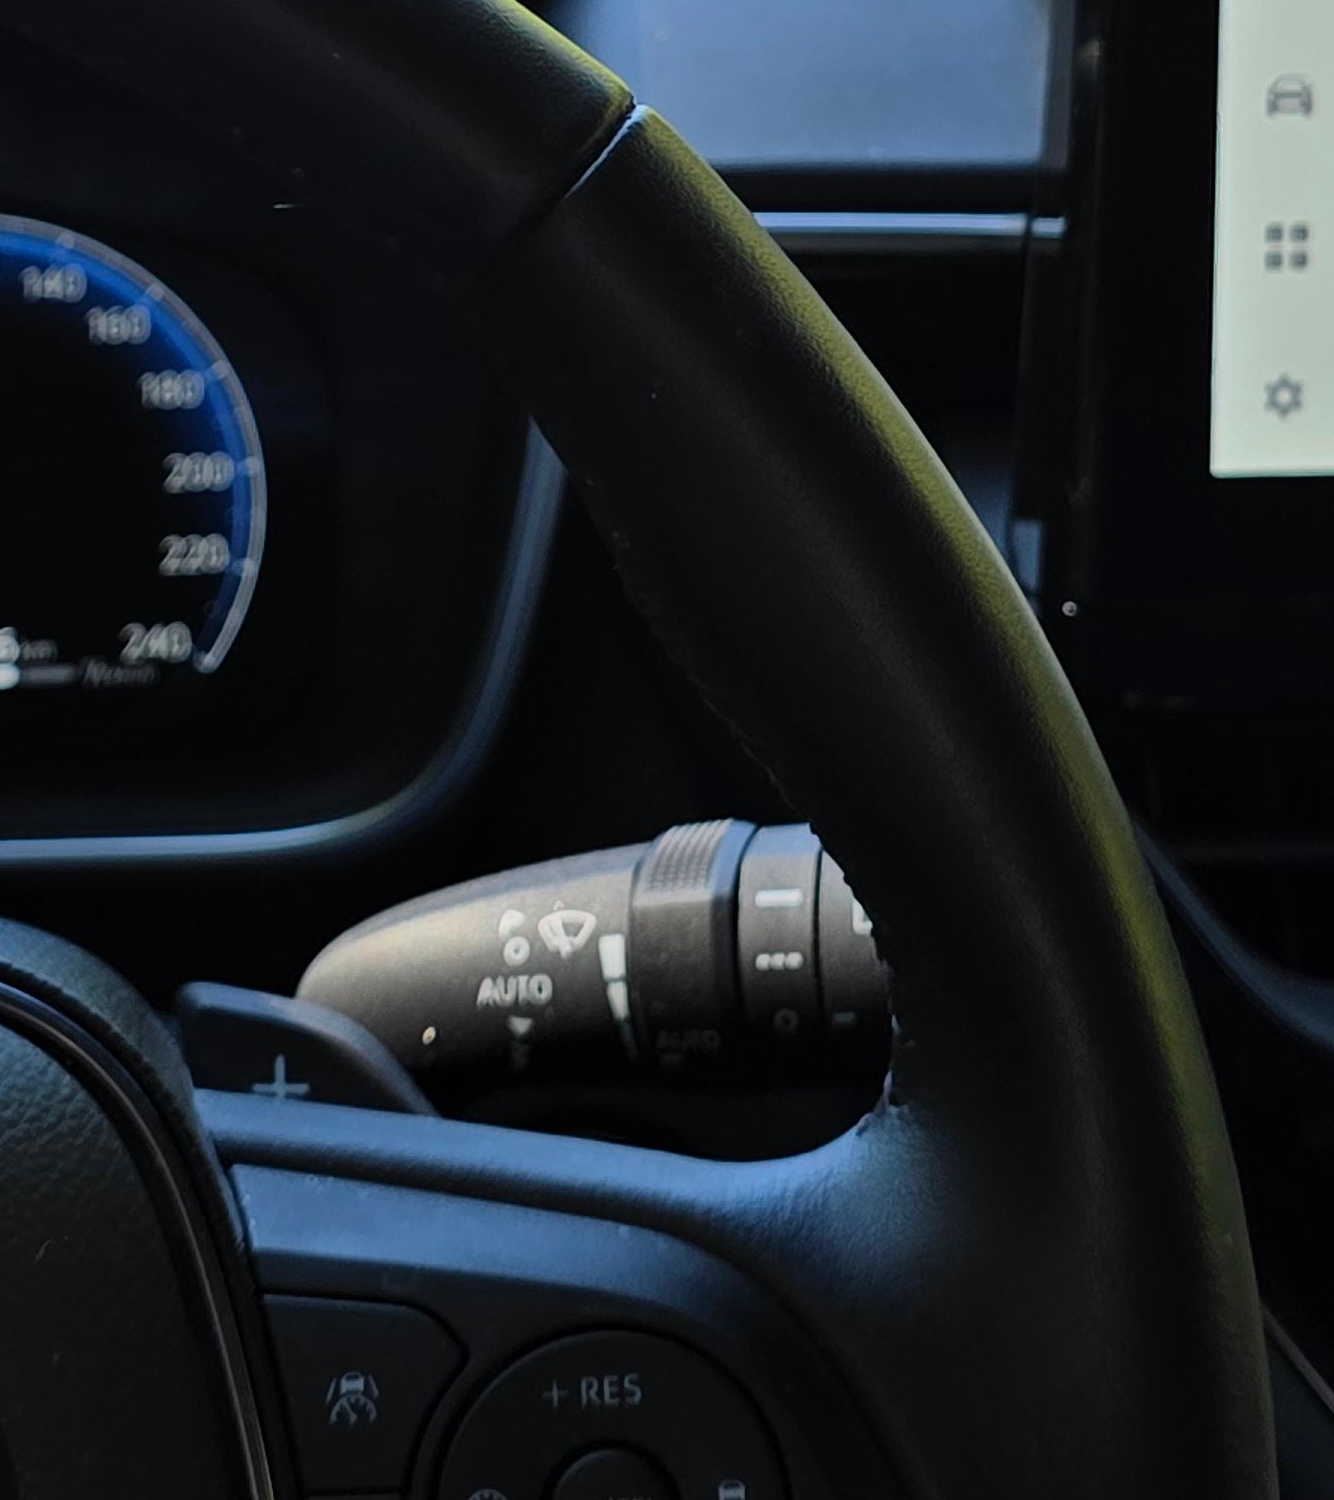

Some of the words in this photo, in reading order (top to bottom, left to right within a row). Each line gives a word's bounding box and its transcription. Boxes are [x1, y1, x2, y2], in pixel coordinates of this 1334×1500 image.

[21, 263, 88, 304] 140
[85, 303, 151, 346] 160
[163, 451, 235, 494] 200
[158, 533, 230, 576] 220
[119, 621, 193, 665] 240
[476, 973, 553, 1009] AUTO
[581, 1372, 643, 1407] RES
